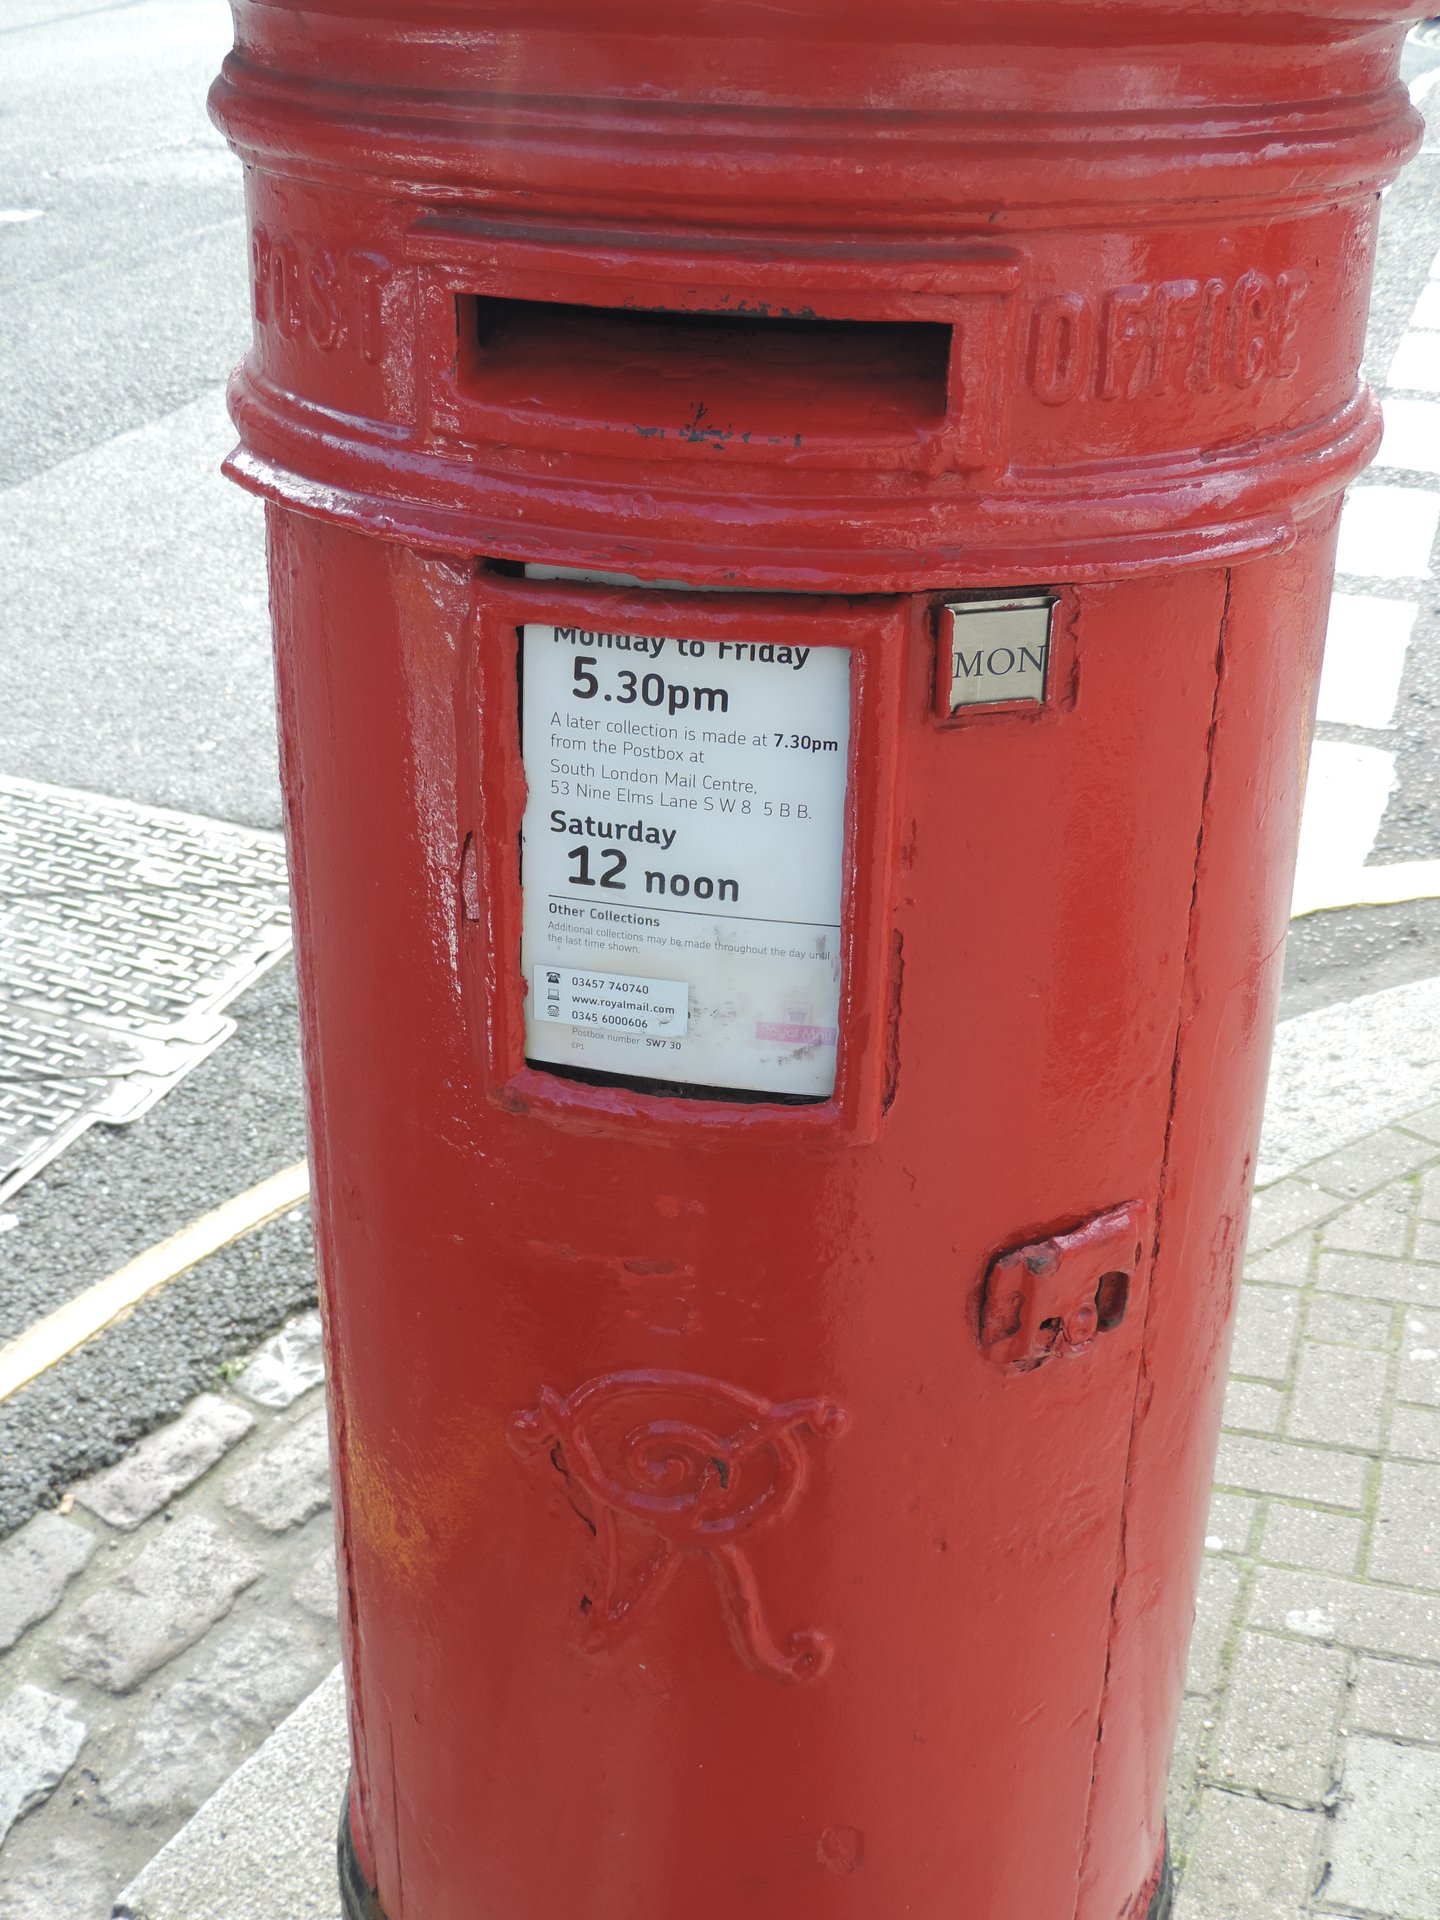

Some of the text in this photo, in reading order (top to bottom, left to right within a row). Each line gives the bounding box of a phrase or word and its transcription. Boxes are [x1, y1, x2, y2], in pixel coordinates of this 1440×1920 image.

[1026, 268, 1308, 408] OFFICE
[553, 627, 811, 670] Monday to Friday
[952, 645, 1047, 679] MON
[572, 655, 730, 716] 5.30pm
[550, 712, 839, 752] A later collection is made at 7.30pm
[550, 734, 705, 764] from the Postbox at
[550, 758, 758, 796] South London Mail Centre,
[550, 780, 570, 796] 53
[576, 783, 611, 801] Nine
[617, 788, 655, 806] Elms
[660, 792, 698, 811] Lane
[550, 809, 677, 850] Saturday
[567, 845, 740, 902] 12 noon
[548, 902, 660, 927] Other Collections
[548, 920, 831, 961] Additional collections may be made throughout the day until
[548, 933, 641, 954] the last time shown.
[571, 976, 649, 995] 03457 740740
[571, 995, 675, 1015] www.royalmail.com
[571, 1010, 648, 1029] 0345 6000606
[572, 1027, 682, 1051] Postbox number SW7 30
